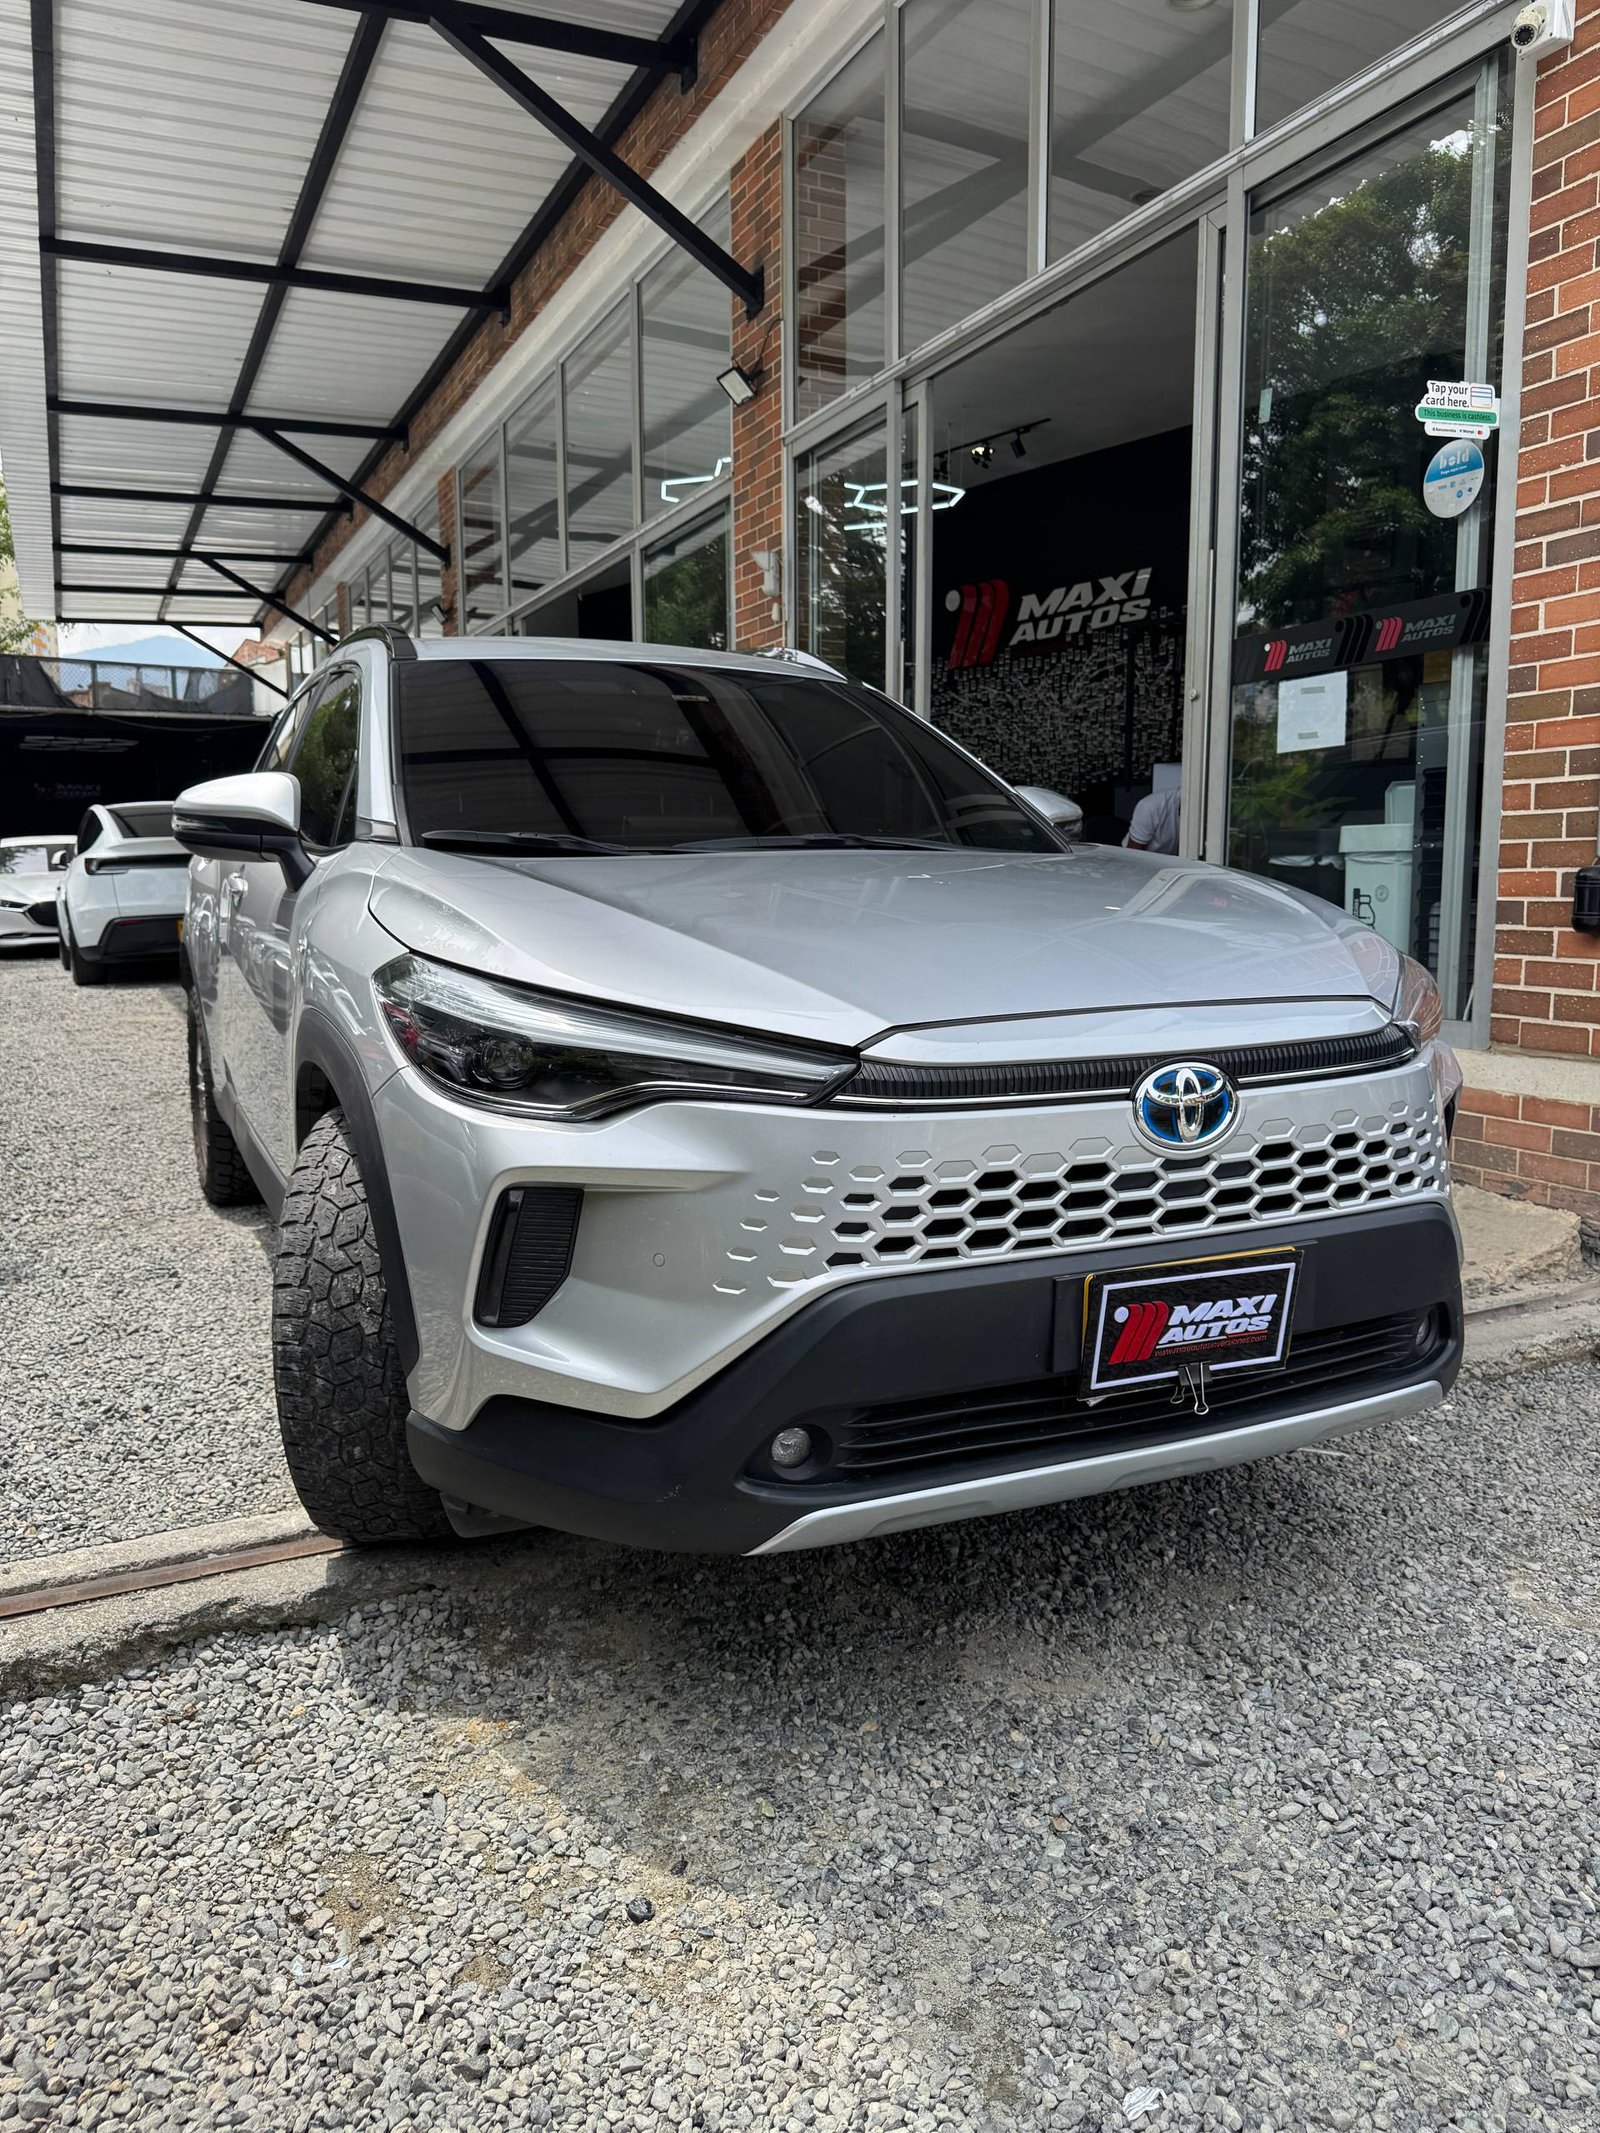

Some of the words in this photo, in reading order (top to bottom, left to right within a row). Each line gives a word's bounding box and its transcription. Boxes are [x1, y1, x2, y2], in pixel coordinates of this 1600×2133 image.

[1430, 382, 1446, 395] Tap
[1448, 385, 1468, 396] your
[1425, 396, 1445, 405] card
[1447, 397, 1470, 408] here.
[1423, 409, 1436, 417] This
[1437, 410, 1461, 419] business
[1462, 411, 1467, 419] is
[1017, 567, 1152, 621] MAXI
[1008, 598, 1151, 646] AUTOS
[1404, 613, 1457, 633] MAXI
[1401, 625, 1455, 642] AUTOS
[1288, 638, 1333, 655] MAXI
[1286, 649, 1330, 664] AUTOS
[1168, 1294, 1277, 1326] MAXI
[1158, 1315, 1272, 1345] AUTOS
